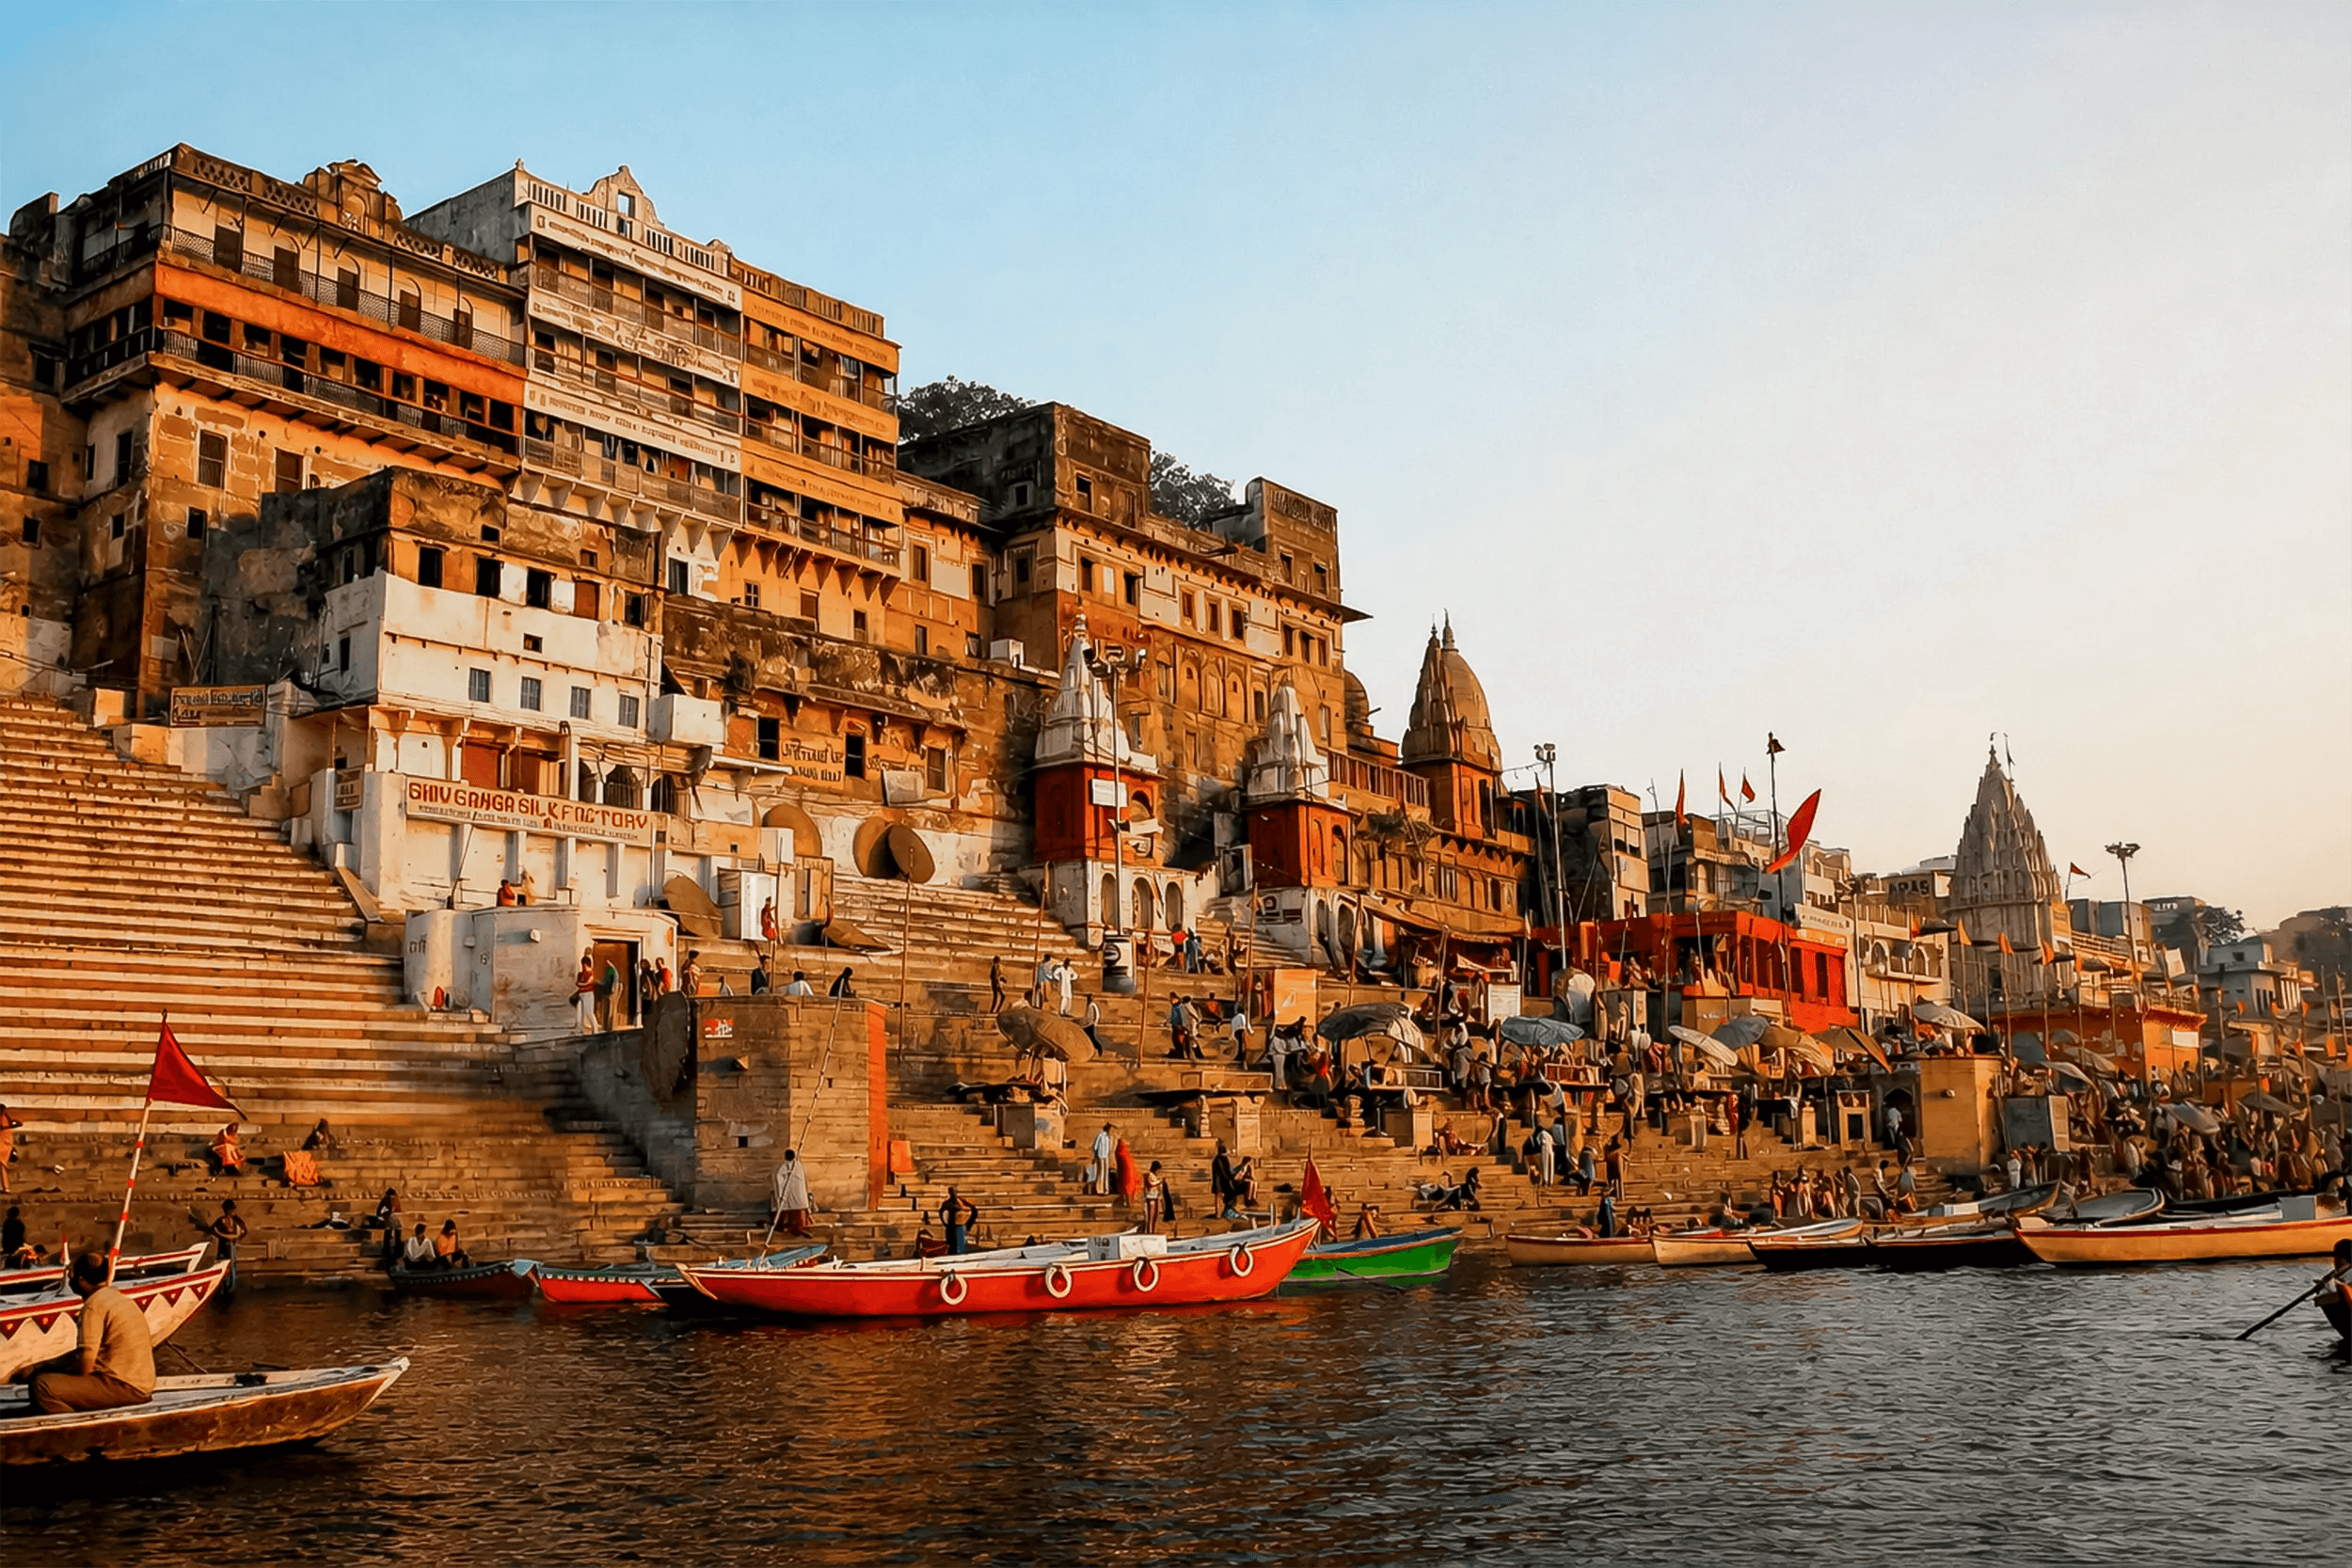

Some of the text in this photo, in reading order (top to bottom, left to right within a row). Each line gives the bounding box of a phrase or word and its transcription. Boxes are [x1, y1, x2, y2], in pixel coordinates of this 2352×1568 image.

[453, 789, 516, 813] GANGA
[518, 798, 558, 820] SILK
[561, 804, 647, 830] FACTORY
